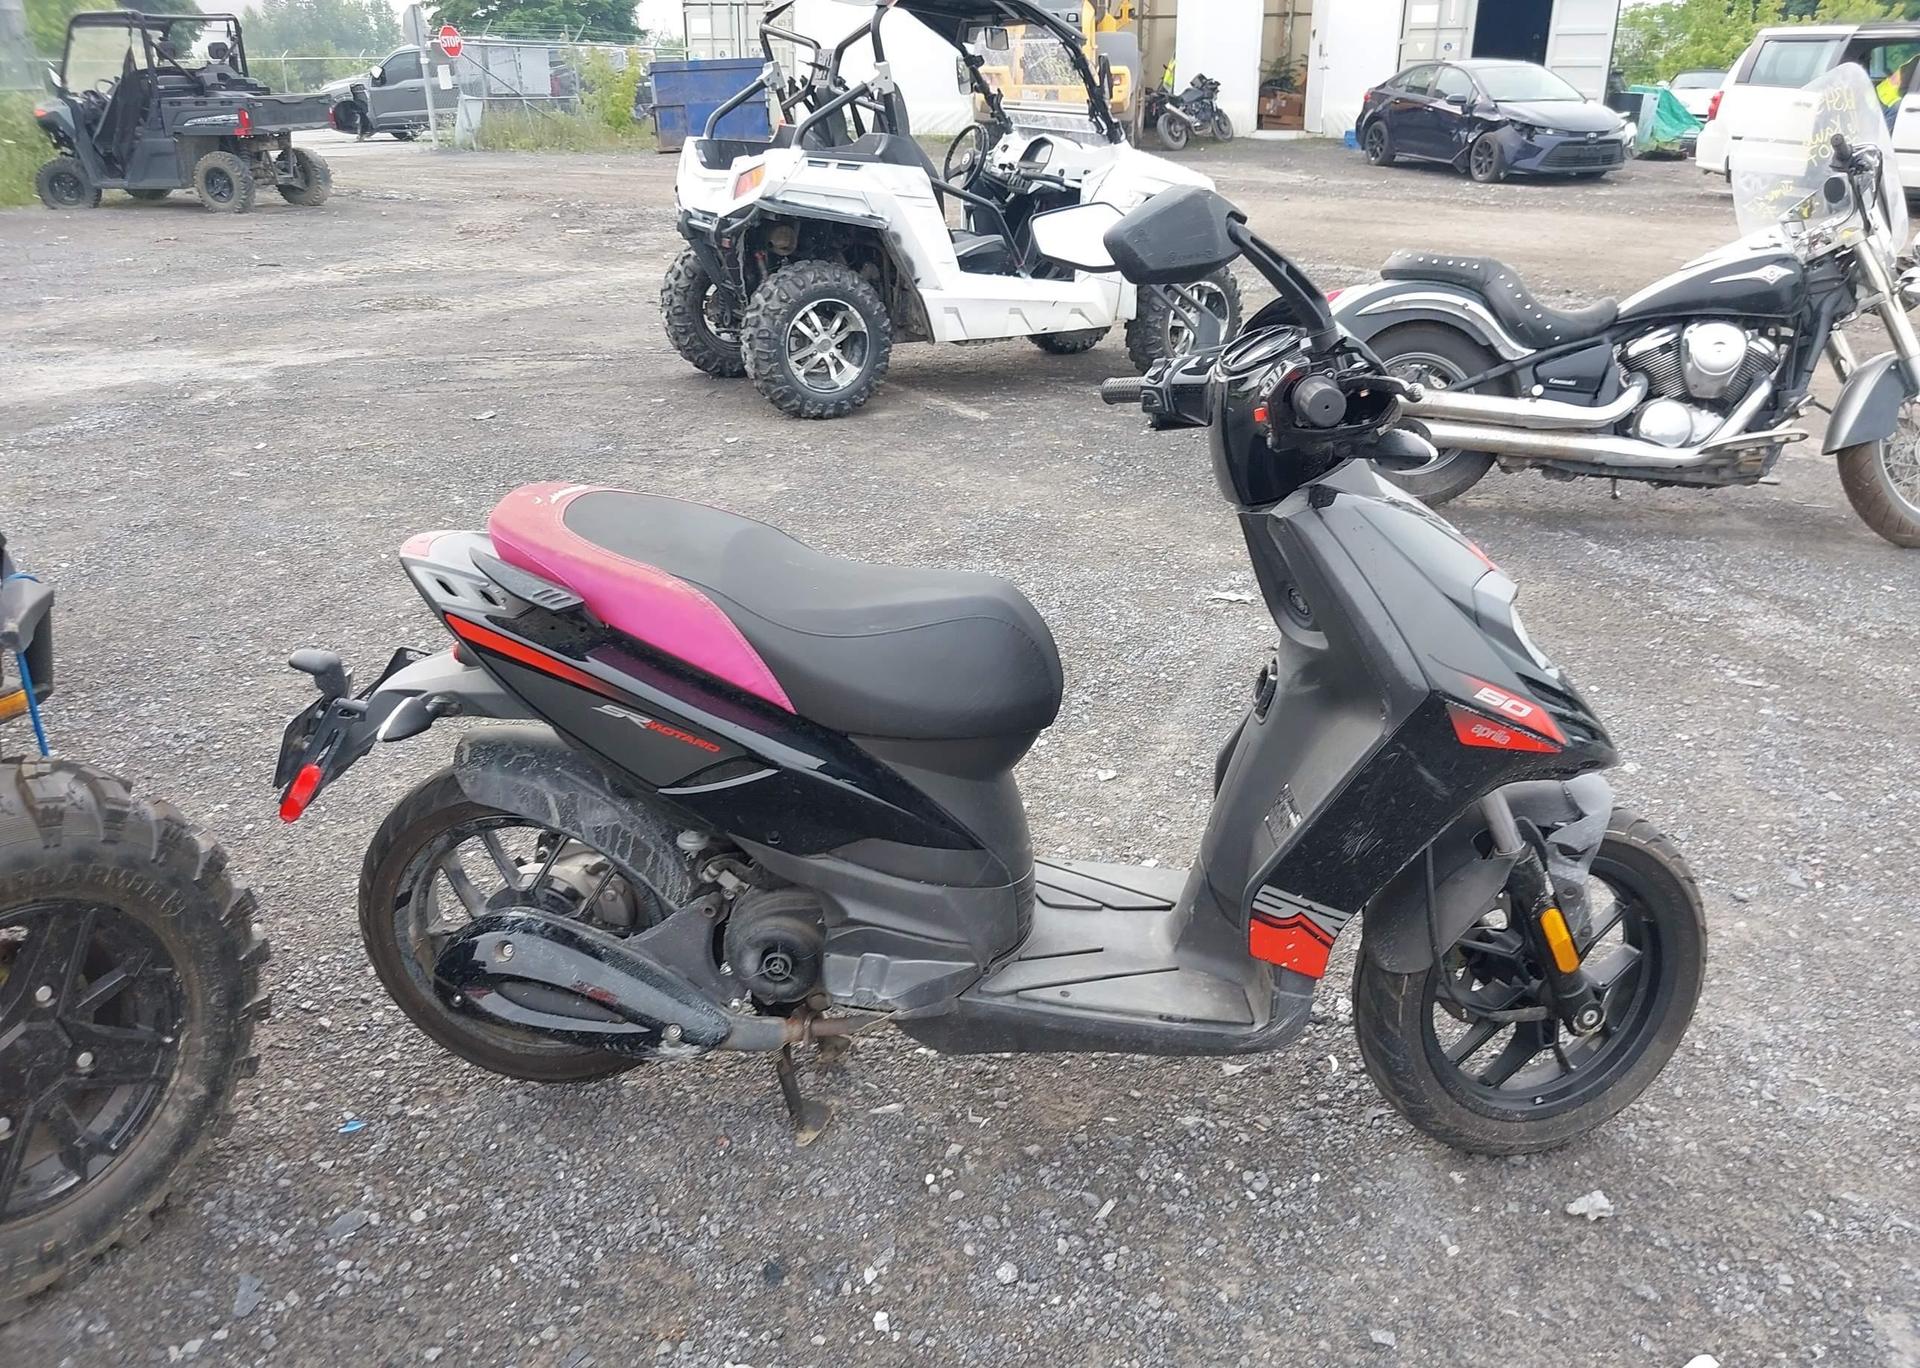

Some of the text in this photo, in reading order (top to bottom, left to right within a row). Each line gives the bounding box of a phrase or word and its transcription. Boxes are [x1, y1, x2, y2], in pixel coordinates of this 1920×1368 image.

[442, 36, 460, 48] STOP
[1473, 686, 1533, 717] 50
[1471, 724, 1511, 745] aprilia
